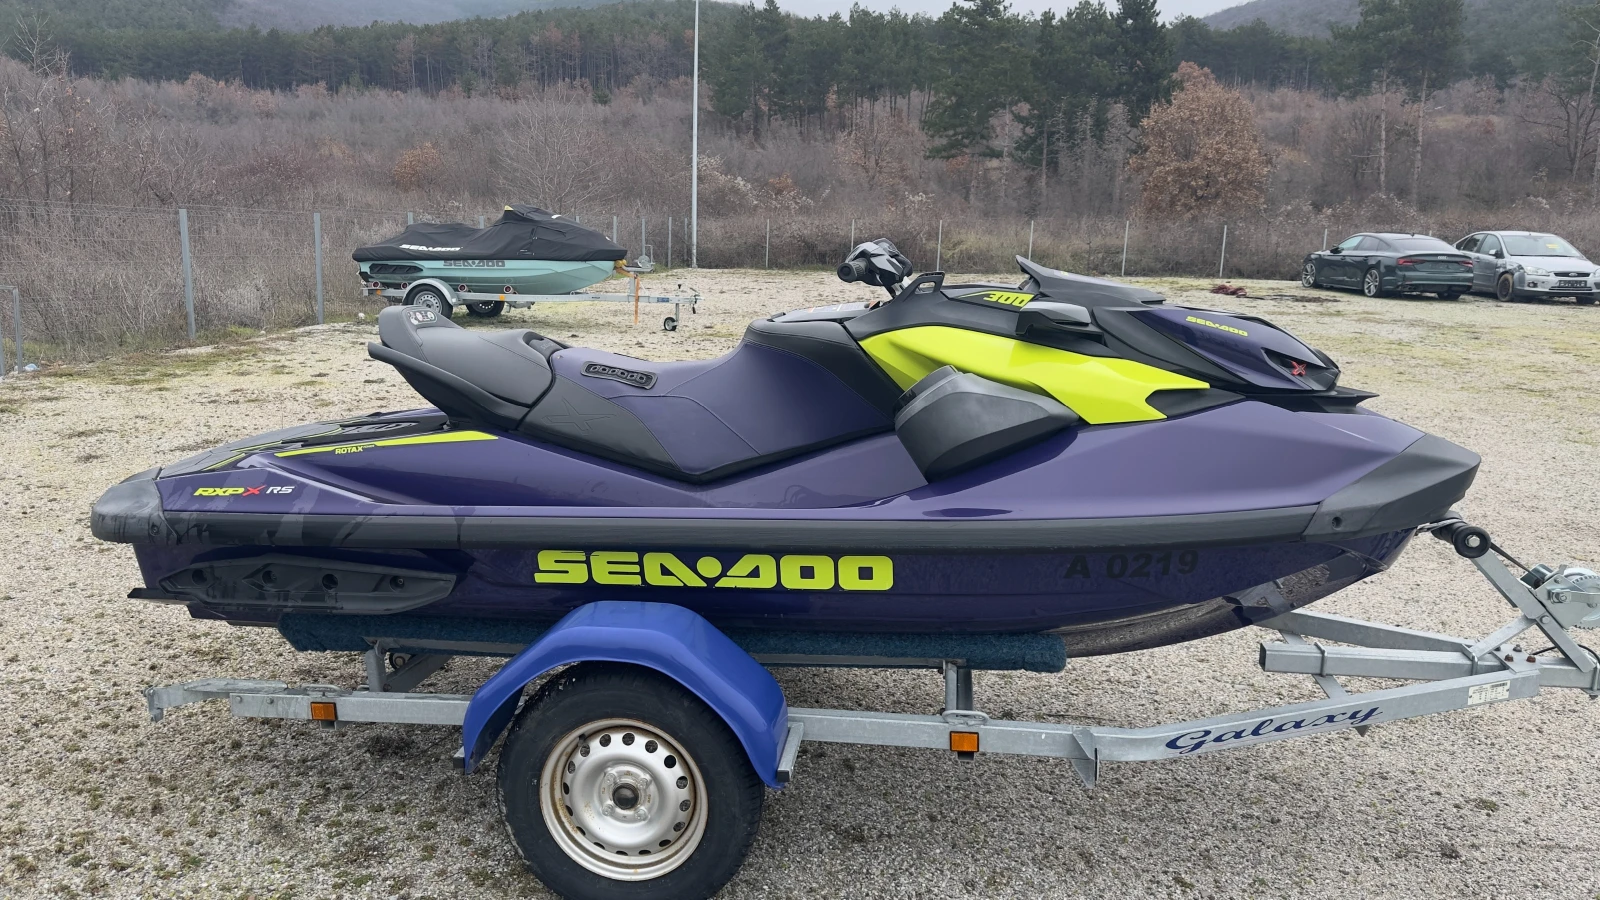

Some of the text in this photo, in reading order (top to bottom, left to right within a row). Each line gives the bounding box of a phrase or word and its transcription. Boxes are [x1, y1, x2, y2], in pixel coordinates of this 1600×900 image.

[983, 291, 1034, 308] 300
[335, 445, 363, 455] ROTAX
[266, 486, 295, 494] RS
[1063, 550, 1199, 579] A 0219
[1165, 706, 1384, 755] Galaxy
